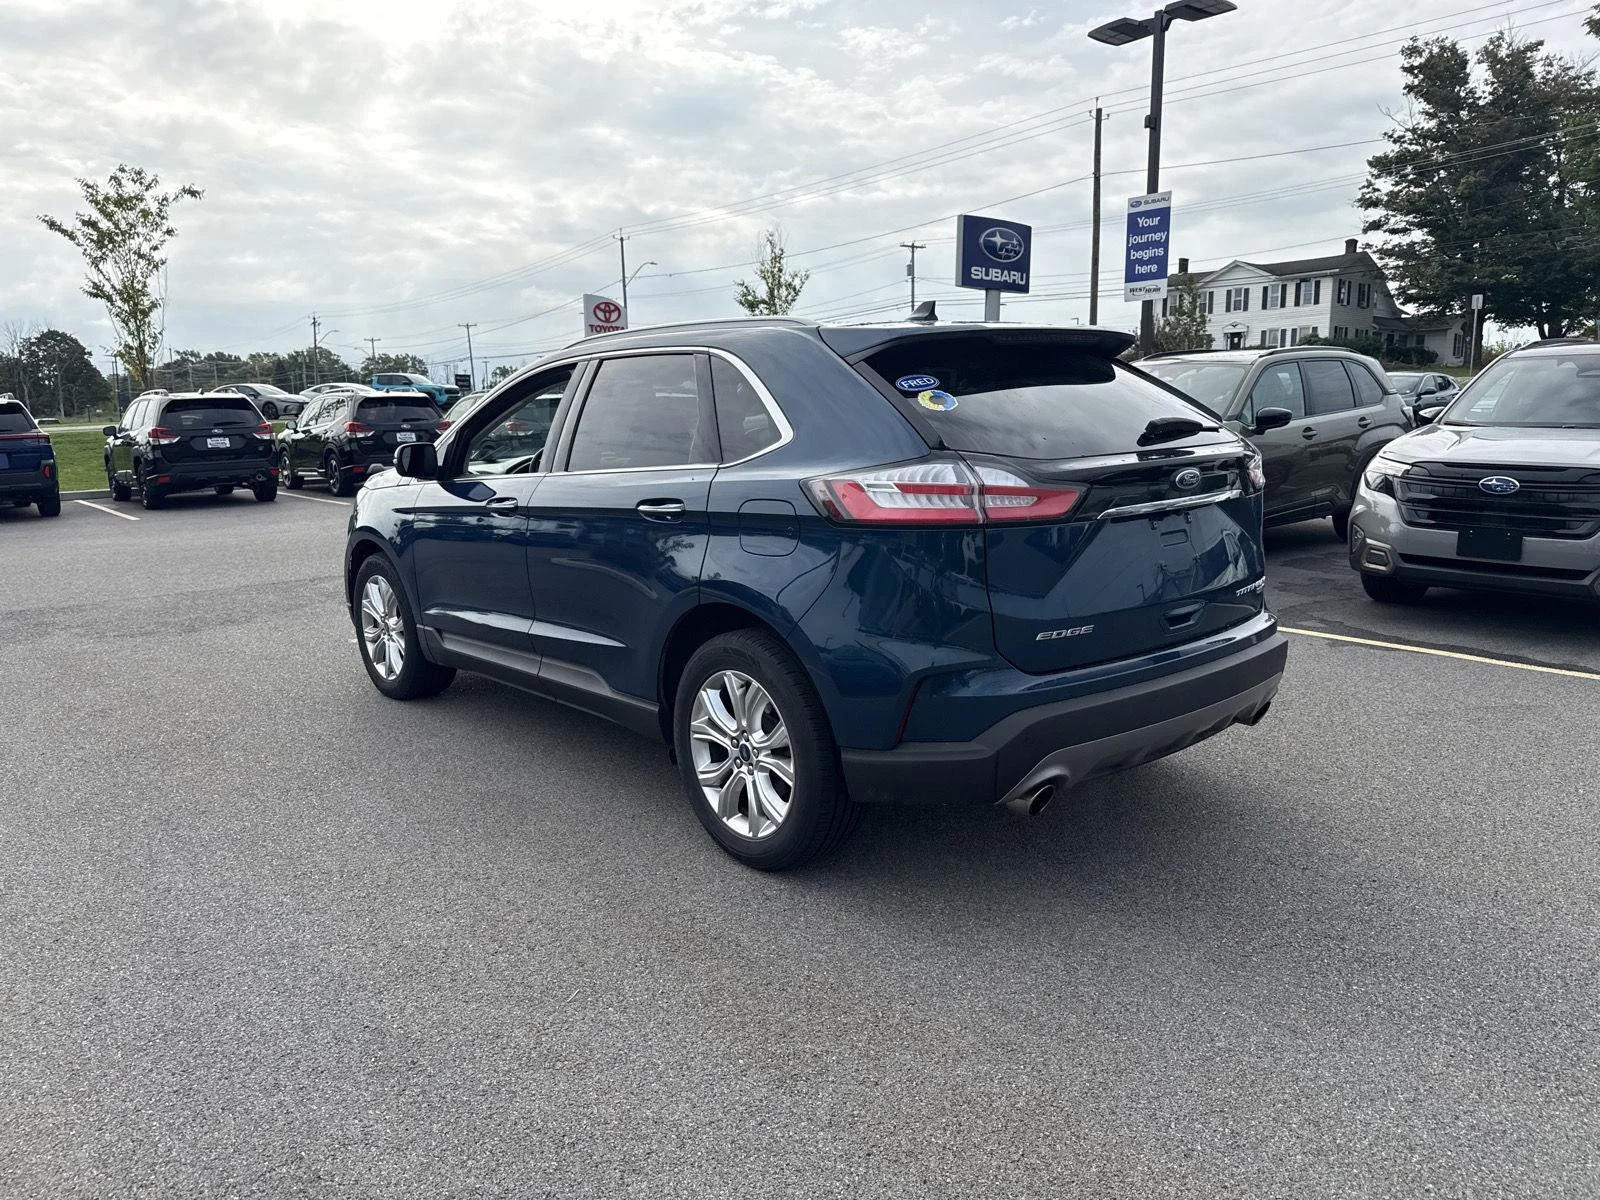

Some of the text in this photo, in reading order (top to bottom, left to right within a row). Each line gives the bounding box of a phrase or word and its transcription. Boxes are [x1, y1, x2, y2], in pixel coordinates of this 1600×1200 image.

[1143, 196, 1170, 206] SUBARU
[1137, 216, 1161, 228] Your
[1128, 231, 1168, 247] journey
[1130, 247, 1164, 261] begins
[970, 266, 1027, 285] SUBARU
[1135, 264, 1158, 275] here
[900, 377, 935, 389] FRED
[1035, 624, 1095, 641] EDGE
